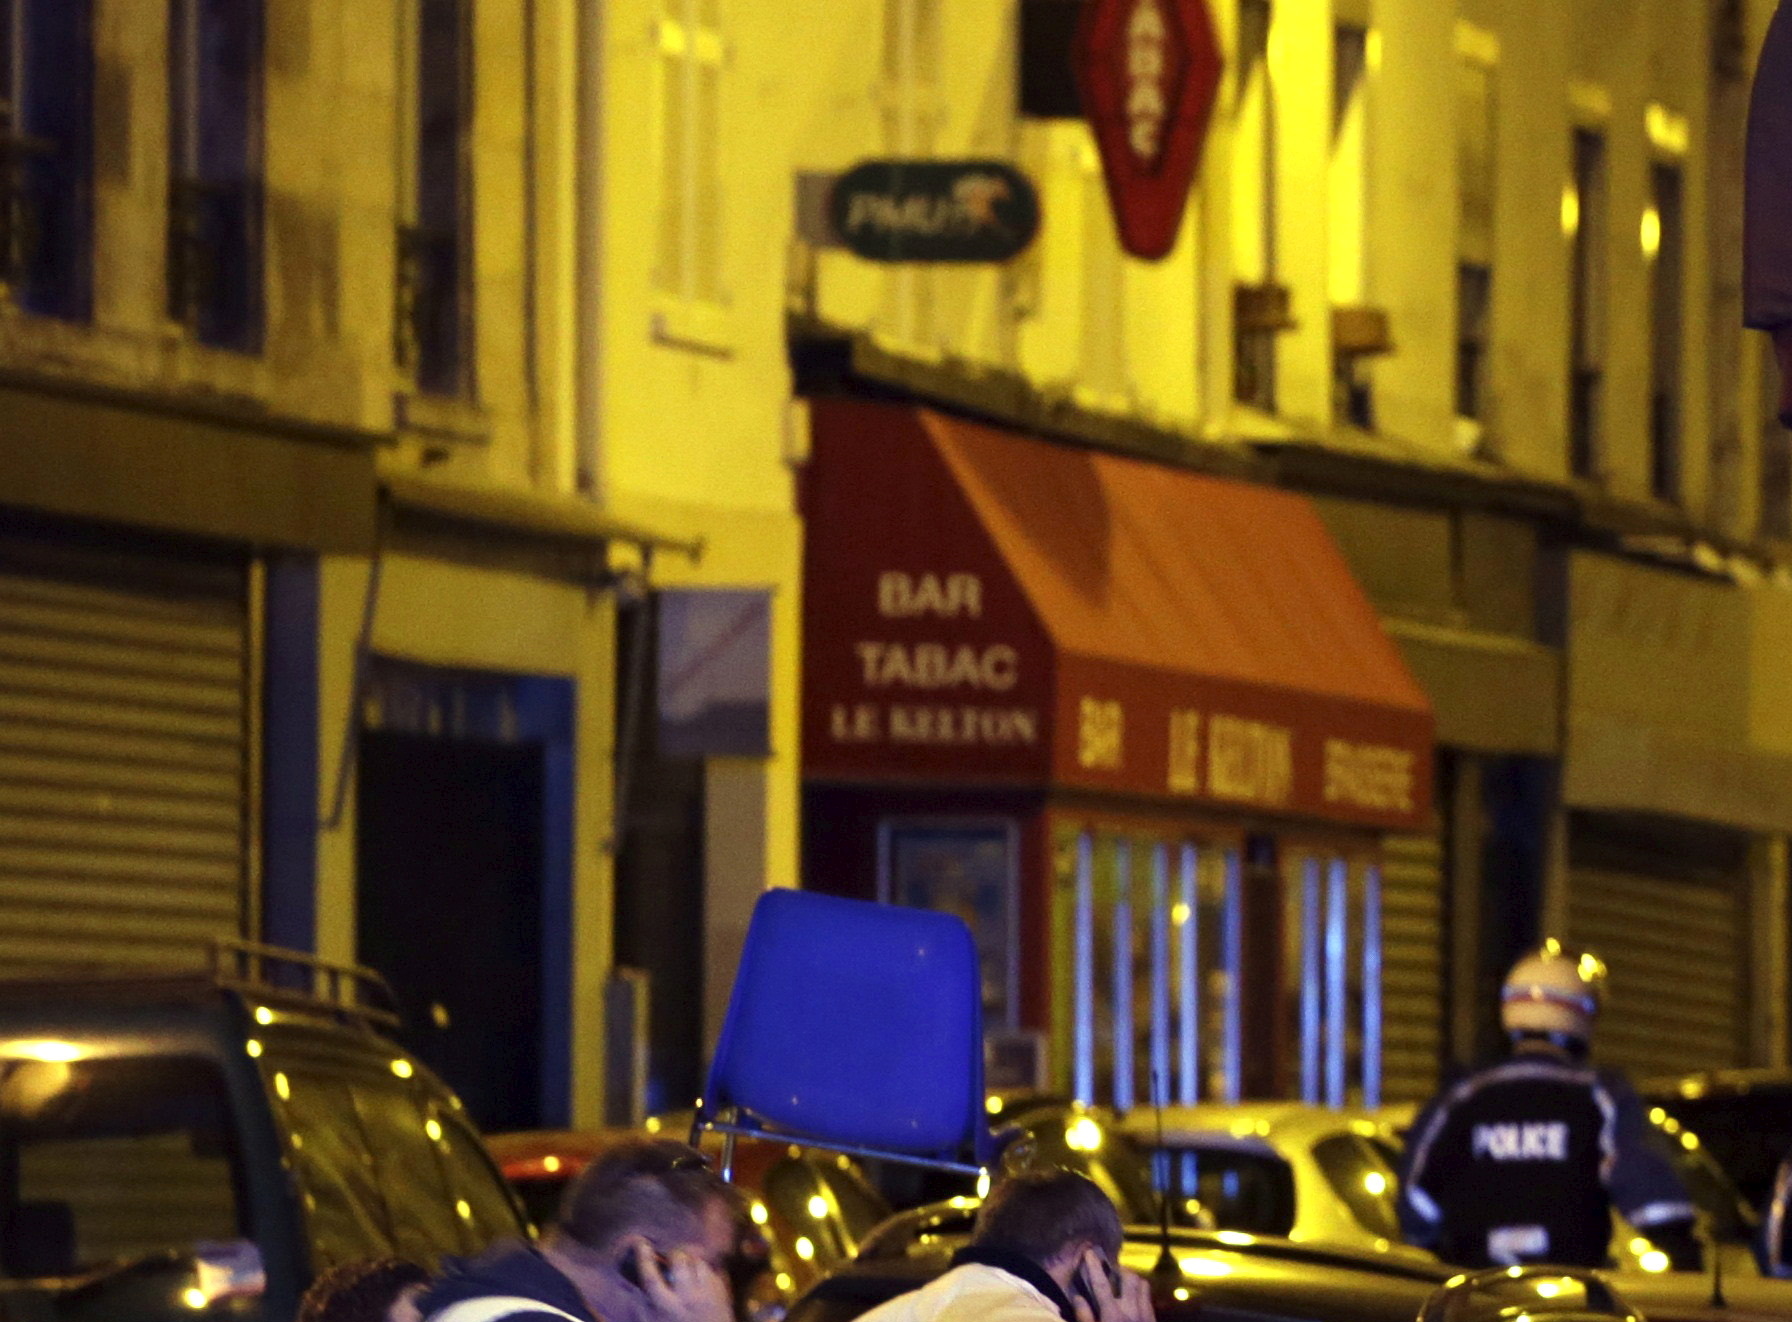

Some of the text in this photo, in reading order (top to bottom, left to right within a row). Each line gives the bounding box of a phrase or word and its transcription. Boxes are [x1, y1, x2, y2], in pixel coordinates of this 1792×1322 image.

[1127, 0, 1166, 158] ABAC
[877, 572, 983, 619] BAR
[855, 642, 1019, 690] TABAC
[832, 704, 882, 743] LE
[1472, 1120, 1569, 1162] POLICE
